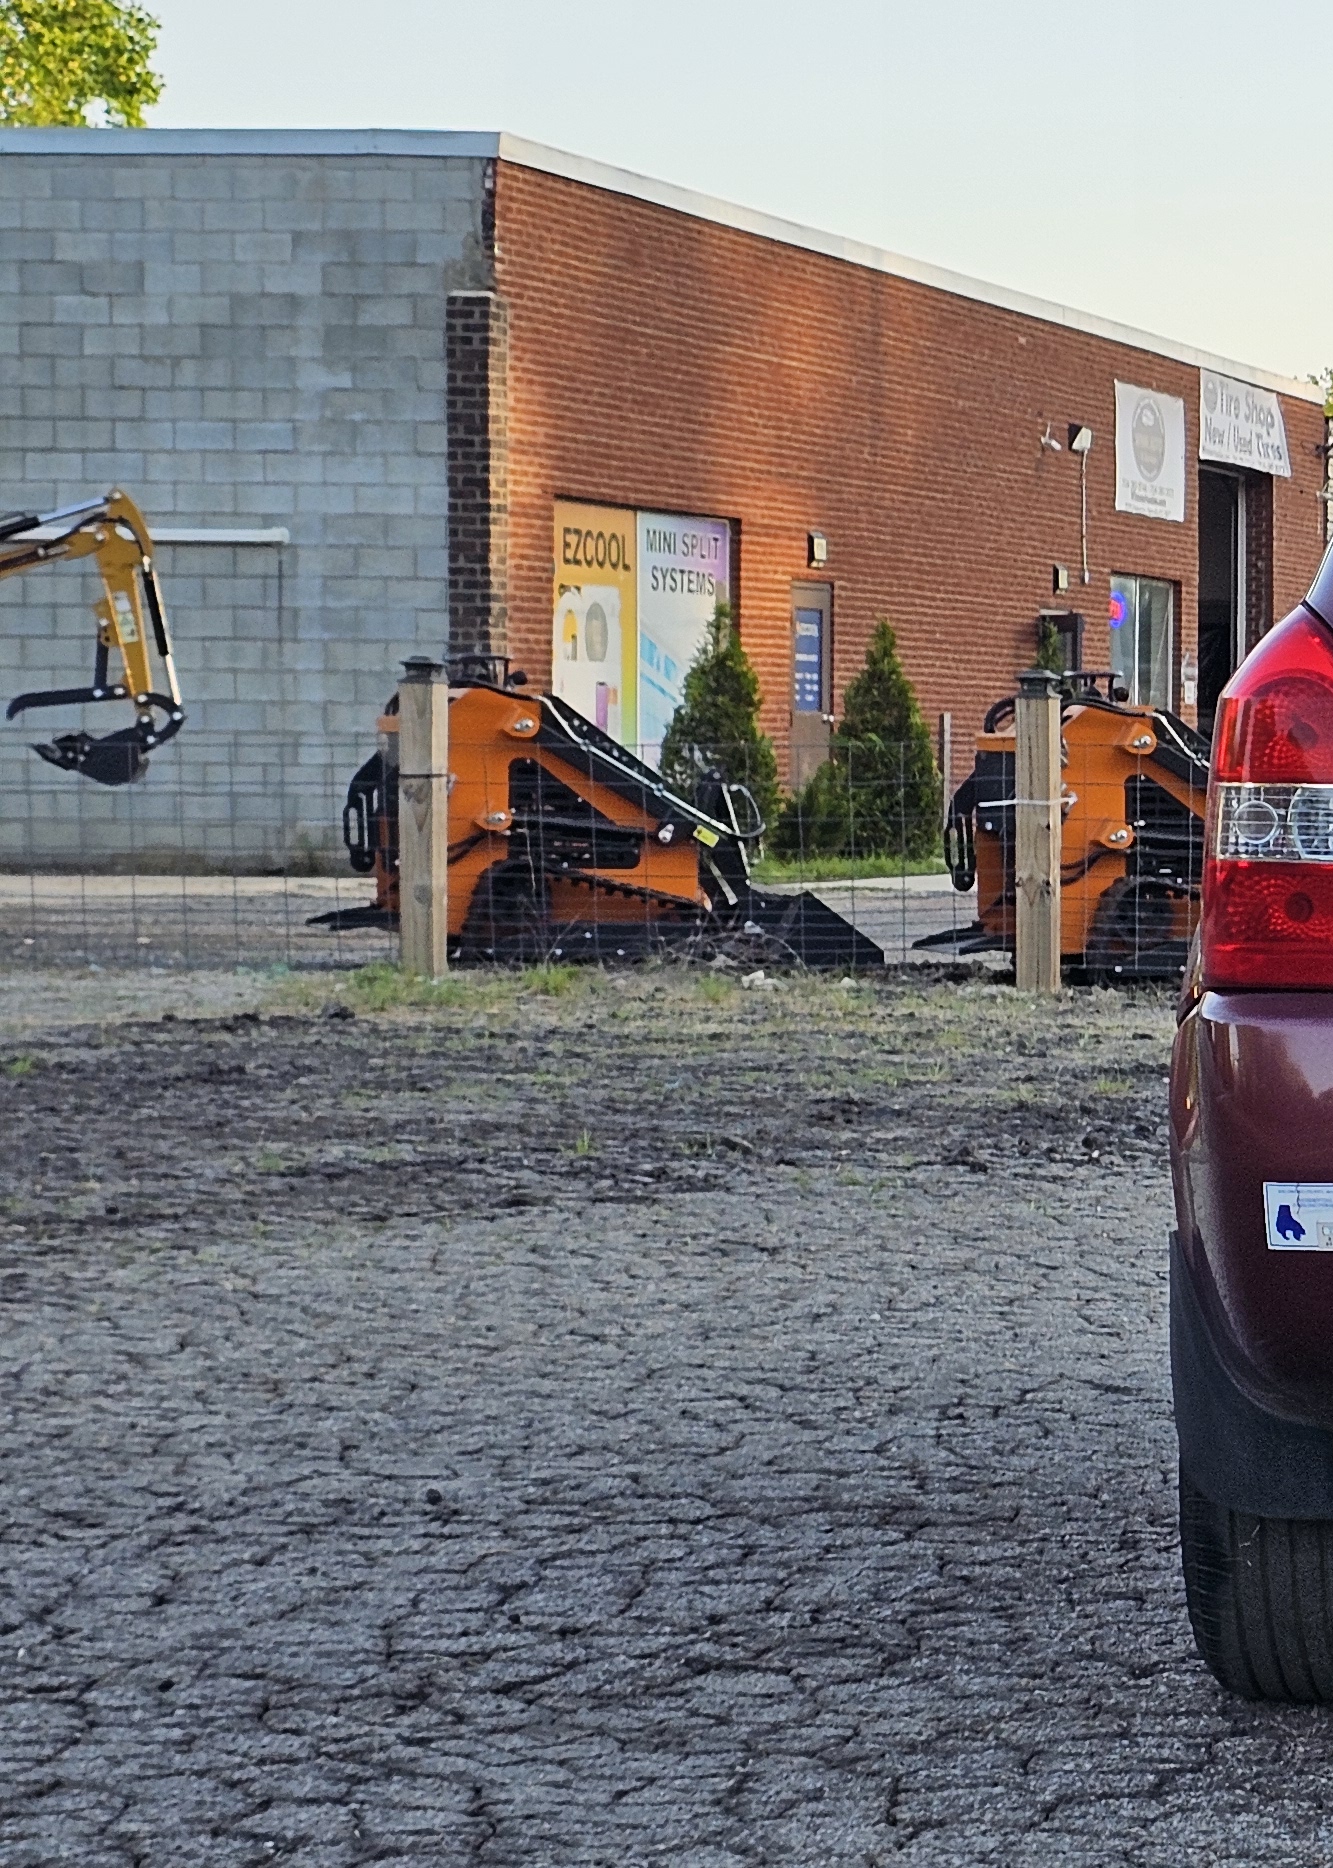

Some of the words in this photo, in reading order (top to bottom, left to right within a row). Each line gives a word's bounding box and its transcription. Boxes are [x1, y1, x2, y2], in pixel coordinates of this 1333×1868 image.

[562, 526, 631, 572] EZCOOL
[646, 528, 678, 556] MINI
[681, 533, 719, 560] SPLIT
[651, 565, 715, 597] SYSTEMS
